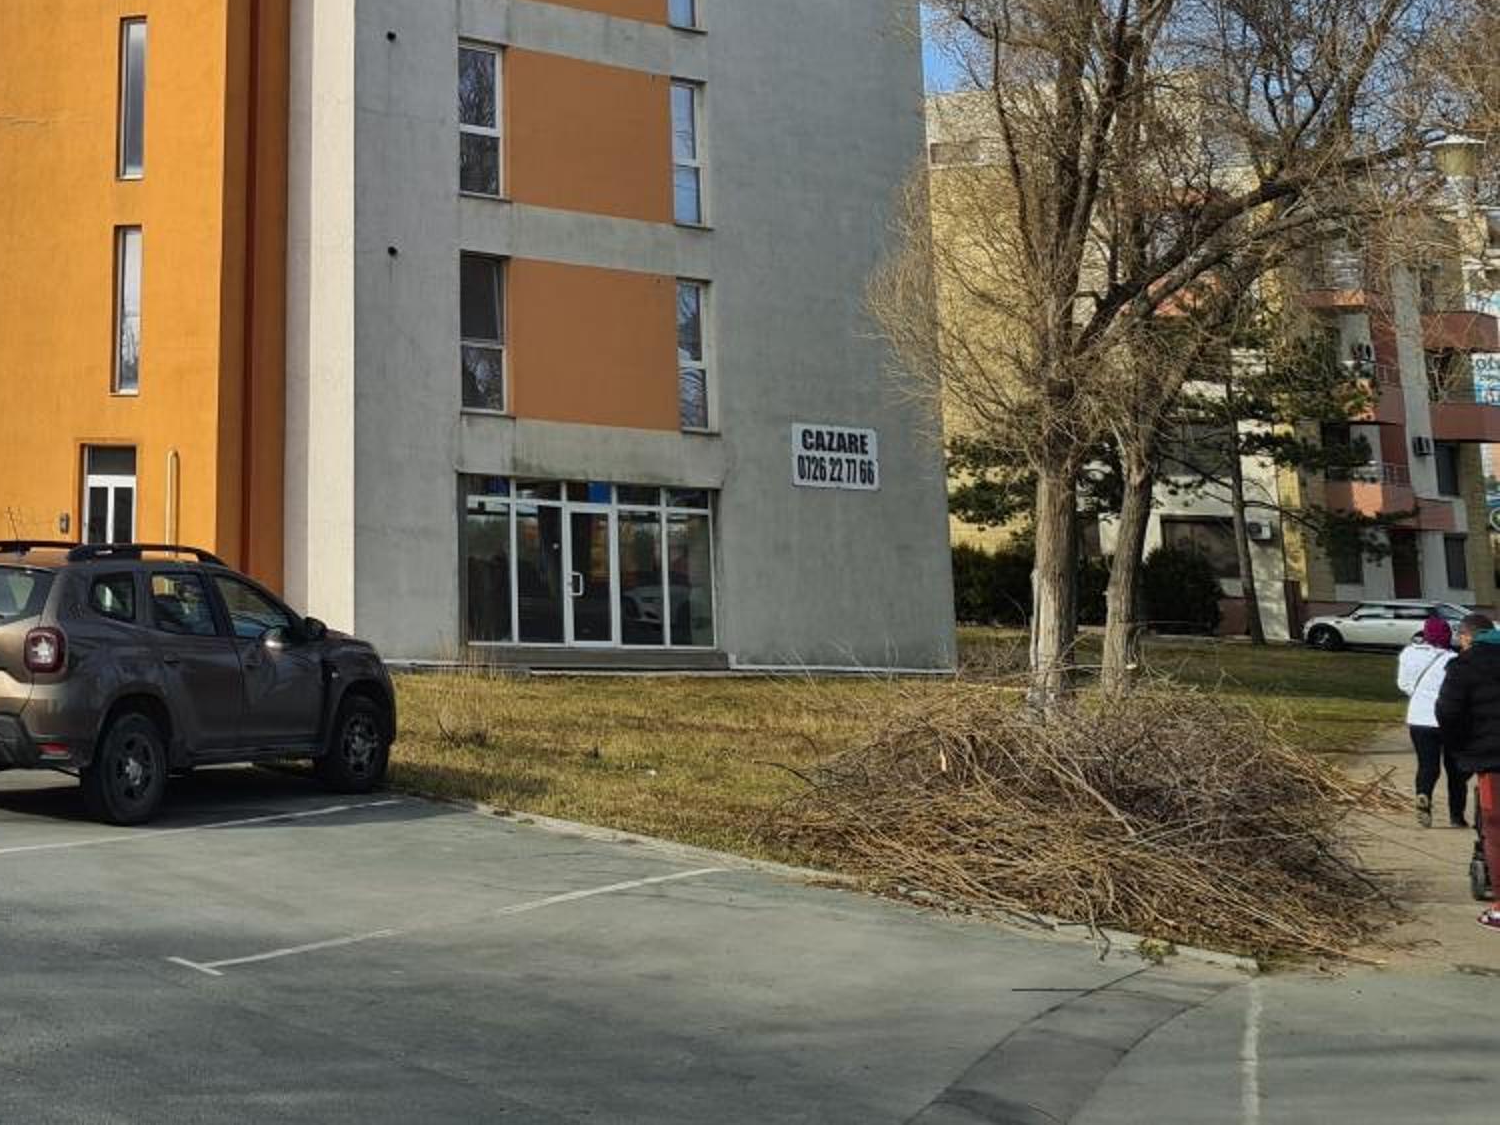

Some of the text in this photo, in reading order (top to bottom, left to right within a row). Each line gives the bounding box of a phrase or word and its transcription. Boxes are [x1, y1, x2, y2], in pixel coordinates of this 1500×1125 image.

[801, 429, 869, 455] CAZARE
[797, 454, 876, 485] 0726 22 77 66
